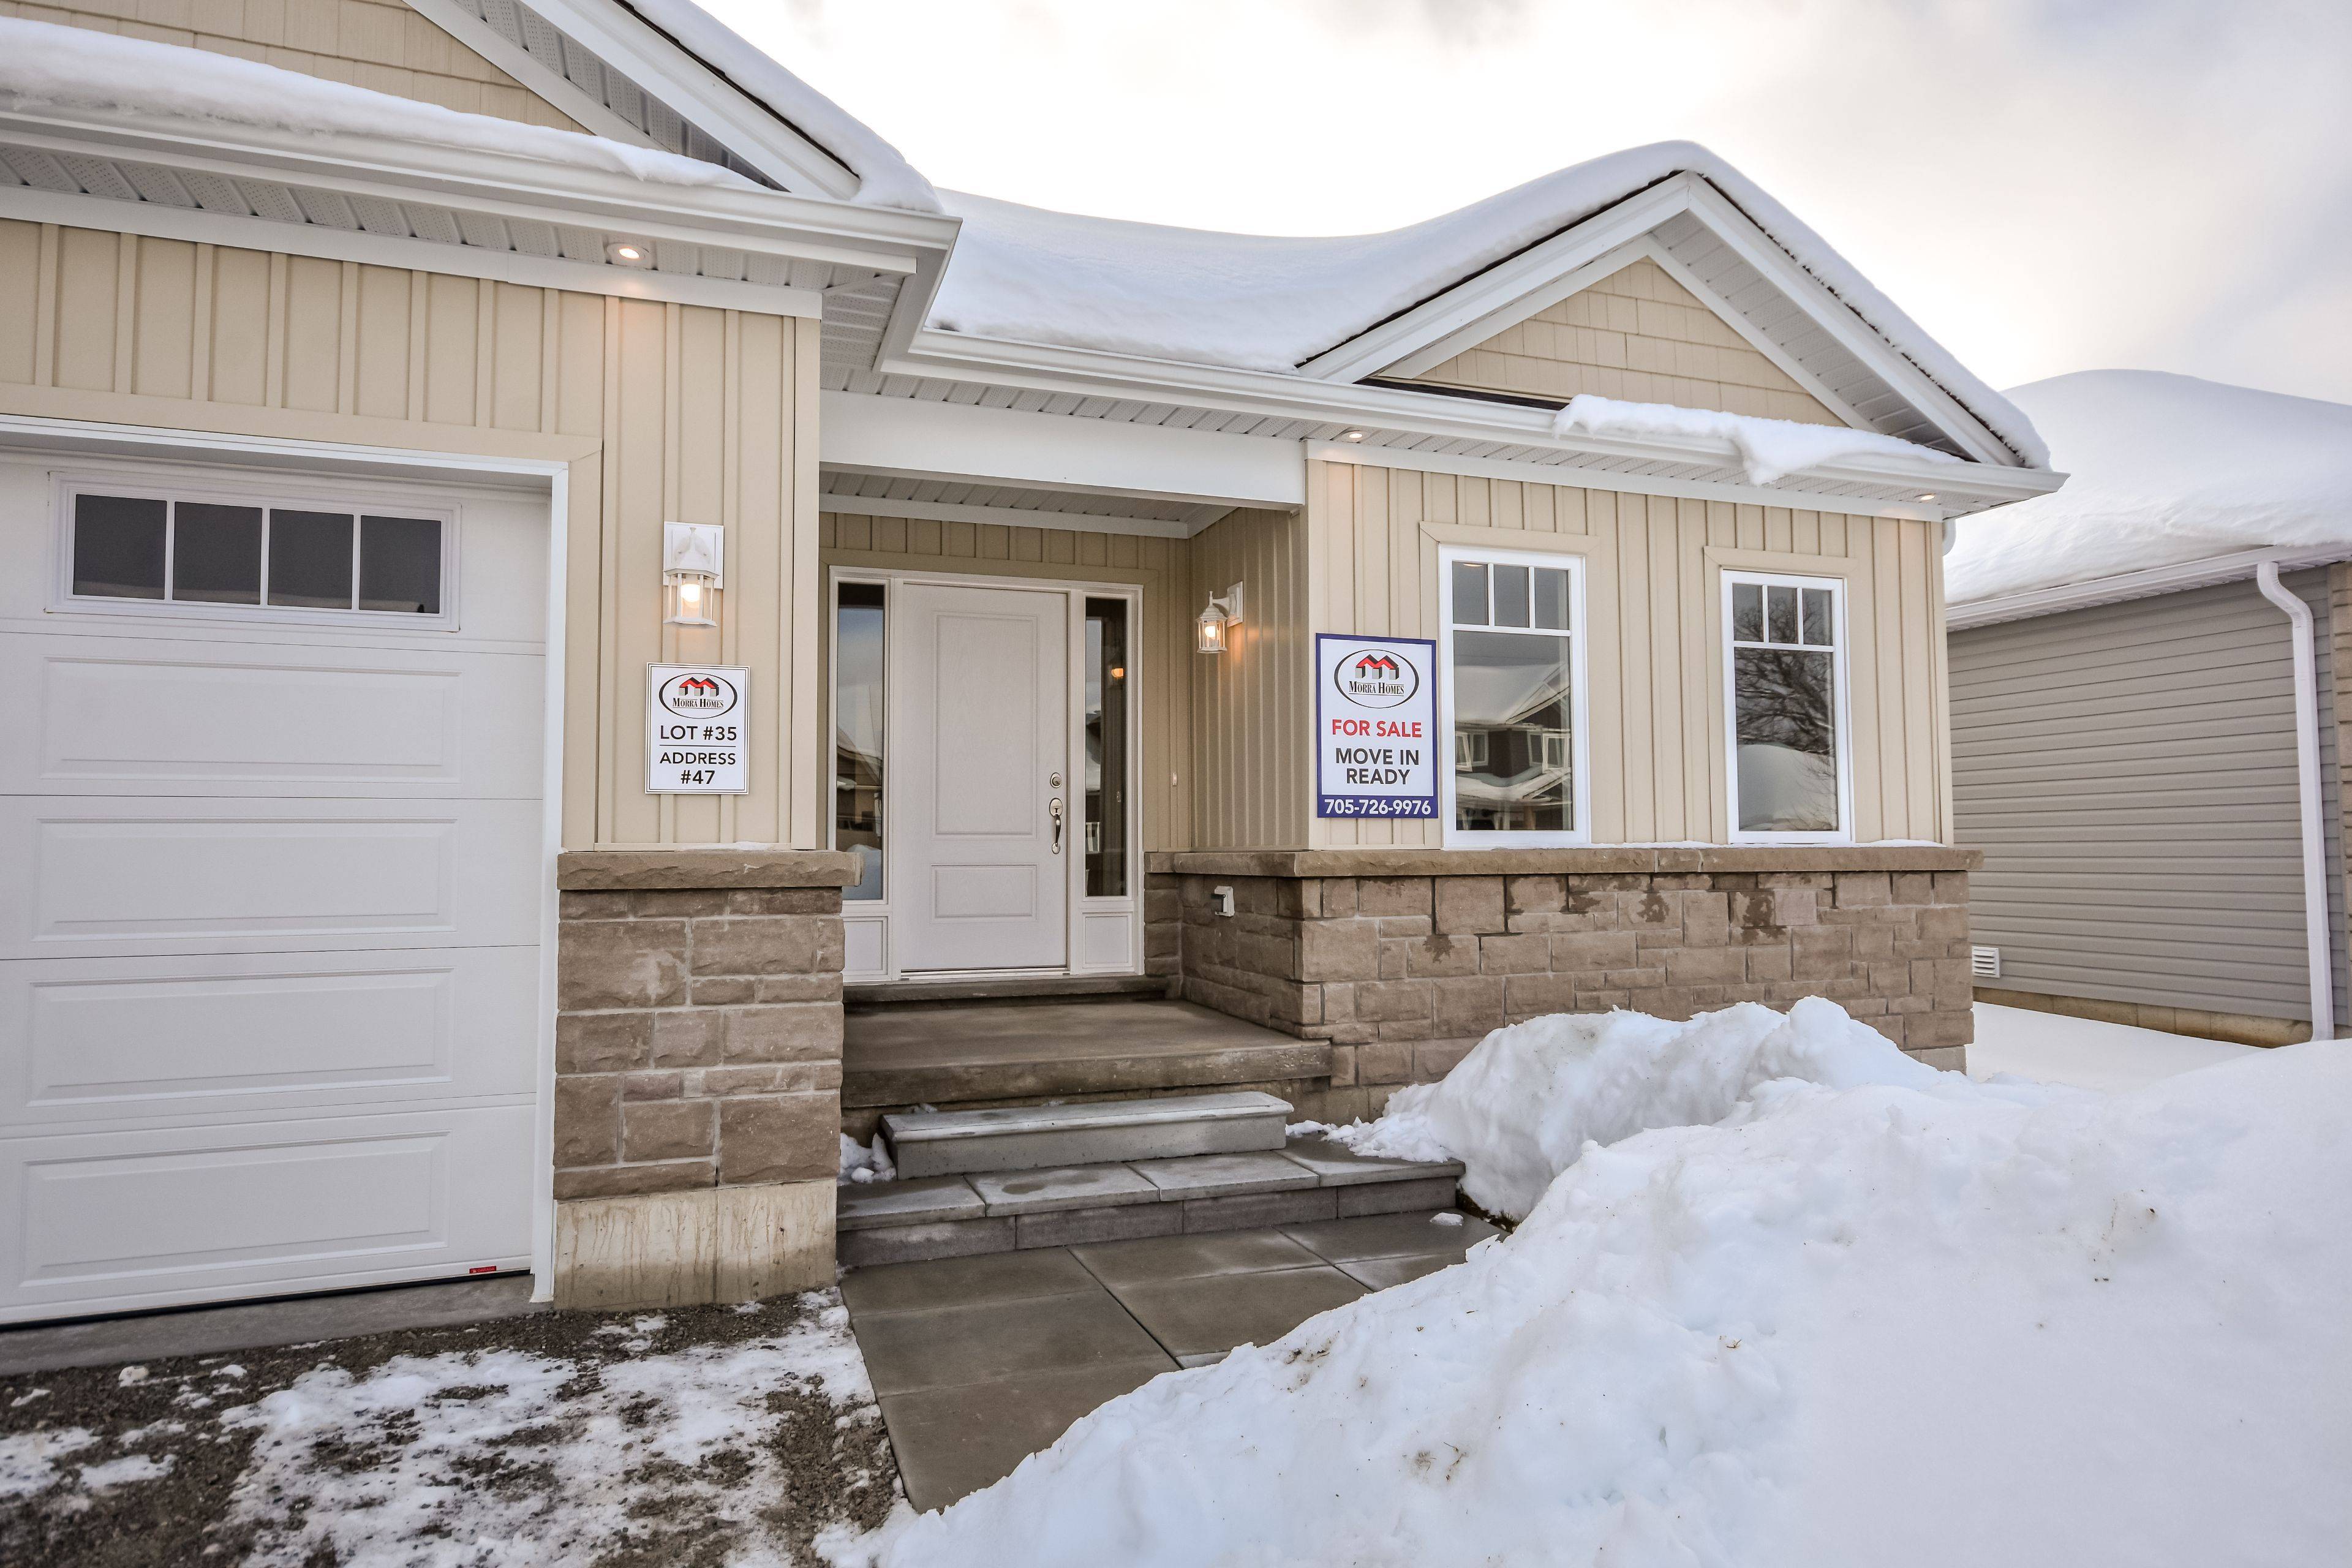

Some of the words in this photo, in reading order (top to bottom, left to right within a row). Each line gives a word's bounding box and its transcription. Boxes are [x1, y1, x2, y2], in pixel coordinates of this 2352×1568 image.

[1349, 680, 1376, 693] MORRA
[1378, 682, 1404, 695] HOMES
[673, 698, 698, 707] MORRA
[699, 698, 724, 708] HOMES
[660, 725, 698, 740] LOT
[703, 726, 737, 741] #35
[1332, 719, 1370, 736] FOR
[1376, 720, 1422, 738] SALE
[660, 752, 736, 765] ADDRESS
[1336, 748, 1393, 765] MOVE
[1400, 749, 1419, 766] IN
[680, 770, 715, 784] #47
[1346, 768, 1411, 785] READY
[1325, 799, 1431, 815] 705-726-9976
